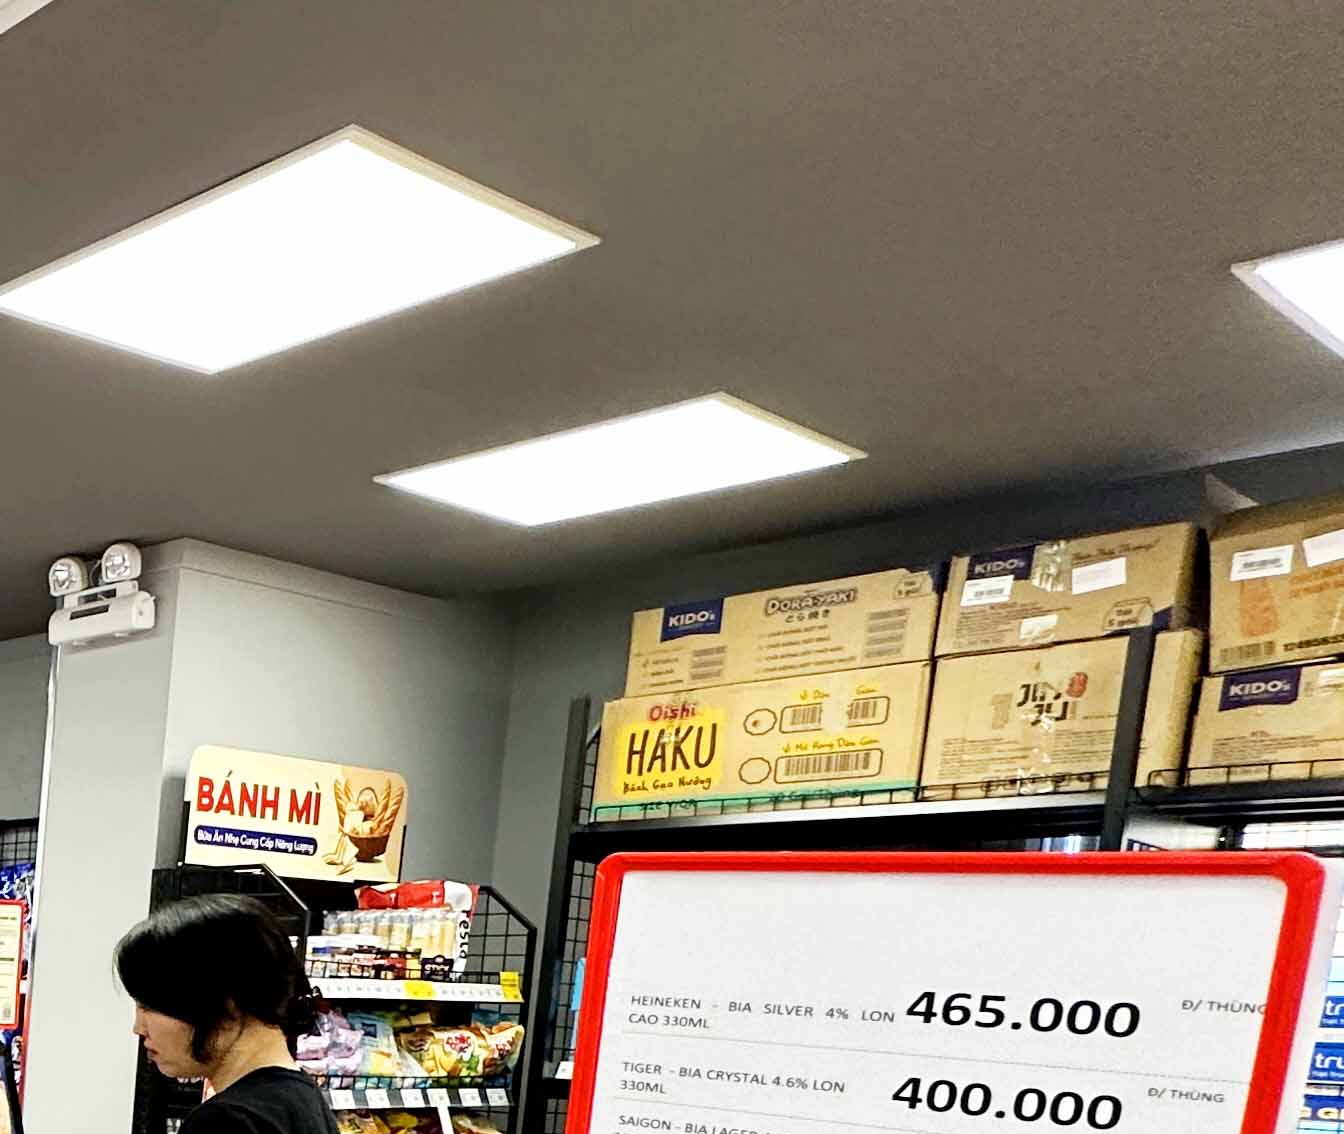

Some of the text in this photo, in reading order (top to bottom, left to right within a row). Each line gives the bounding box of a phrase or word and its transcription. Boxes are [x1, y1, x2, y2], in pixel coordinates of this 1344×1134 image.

[649, 702, 698, 721] Oishi
[626, 723, 718, 776] HAKU
[196, 770, 321, 826] BÁNH MÌ
[628, 1013, 710, 1029] CAO 330ML
[631, 995, 895, 1023] HEINEKEN BIA SILVER 4% LON
[906, 991, 1141, 1038] 465.000
[619, 1080, 667, 1094] 330ML
[623, 1062, 845, 1093] TIGER BIA CRYSTAL 4.6% LON
[891, 1077, 1124, 1130] 400.000
[1168, 1088, 1225, 1103] THÙNG
[618, 1115, 672, 1131] SAIGON
[684, 1122, 708, 1134] BIA
